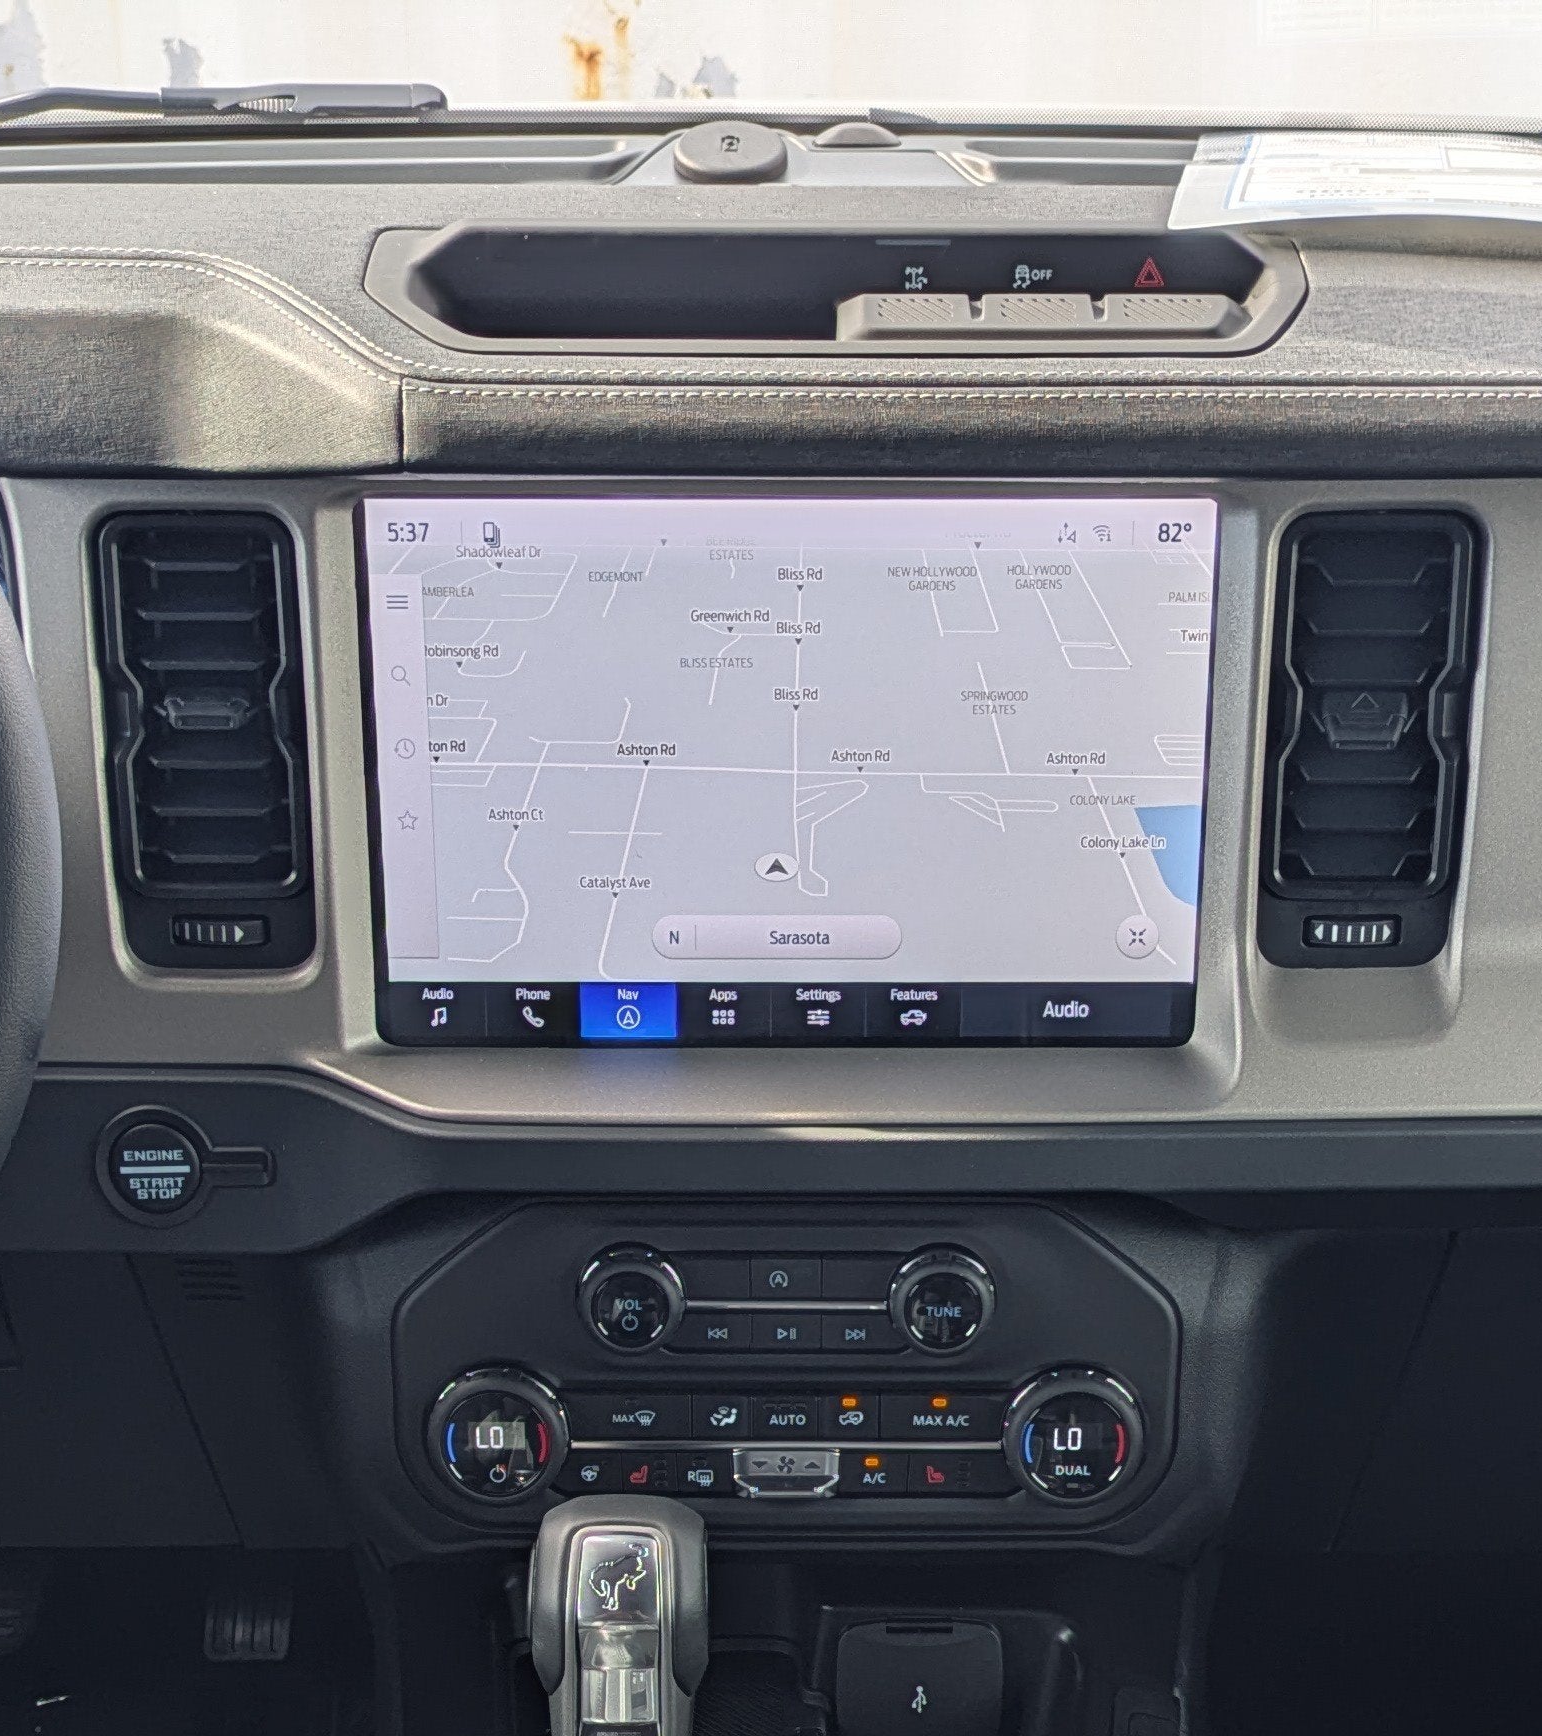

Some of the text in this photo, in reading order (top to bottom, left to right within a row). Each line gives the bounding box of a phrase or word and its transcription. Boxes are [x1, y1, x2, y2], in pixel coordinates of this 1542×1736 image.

[1031, 269, 1053, 281] OFF
[387, 522, 429, 543] 5:37
[1158, 522, 1193, 543] 82°
[456, 545, 542, 559] Shadowleaf Dr
[709, 549, 755, 560] ESTATES
[777, 568, 822, 580] Bliss Rd
[888, 566, 978, 577] NEW HOLLYWOOD
[1007, 564, 1071, 576] HOLLYWOOD
[589, 571, 643, 583] EDGEMONT
[908, 580, 956, 592] GARDENS
[1015, 578, 1063, 590] GARDENS
[1169, 592, 1194, 603] PALM
[690, 609, 770, 623] Greenwich Rd
[776, 622, 821, 634] Bliss Rd
[483, 645, 499, 657] Rd
[680, 657, 754, 669] BLISS ESTATES
[436, 695, 449, 706] Dr
[774, 688, 818, 701] Bliss Rd
[960, 690, 1028, 702] SPRINGWOOD
[972, 704, 1016, 716] ESTATES
[449, 741, 466, 753] Rd
[617, 743, 676, 756] Ashton Rd
[831, 749, 890, 763] Ashton Rd
[1046, 752, 1106, 765] Ashton Rd
[1070, 794, 1136, 806] COLONY LAKE
[488, 808, 544, 821] Ashton Ct
[1080, 836, 1166, 850] Colony Lake Ln
[579, 876, 651, 889] Catalyst Ave
[669, 931, 679, 945] N
[769, 930, 830, 945] Sarasota
[422, 987, 454, 1001] Audio
[515, 987, 550, 1001] Phone
[617, 987, 638, 1001] Nav
[709, 988, 737, 1004] Apps
[796, 988, 841, 1004] Settings
[890, 988, 938, 1001] Features
[1043, 1000, 1090, 1018] Audio
[123, 1149, 184, 1162] ENGINE
[129, 1177, 186, 1189] START
[137, 1188, 182, 1200] STOP
[615, 1298, 643, 1311] VOL
[925, 1305, 962, 1318] TUNE
[612, 1413, 635, 1423] MAX
[769, 1414, 806, 1426] AUTO
[913, 1414, 970, 1427] MAX A/C
[475, 1426, 504, 1449] LO
[1053, 1427, 1082, 1451] LO
[1055, 1465, 1091, 1476] DUAL
[863, 1472, 886, 1484] A/C
